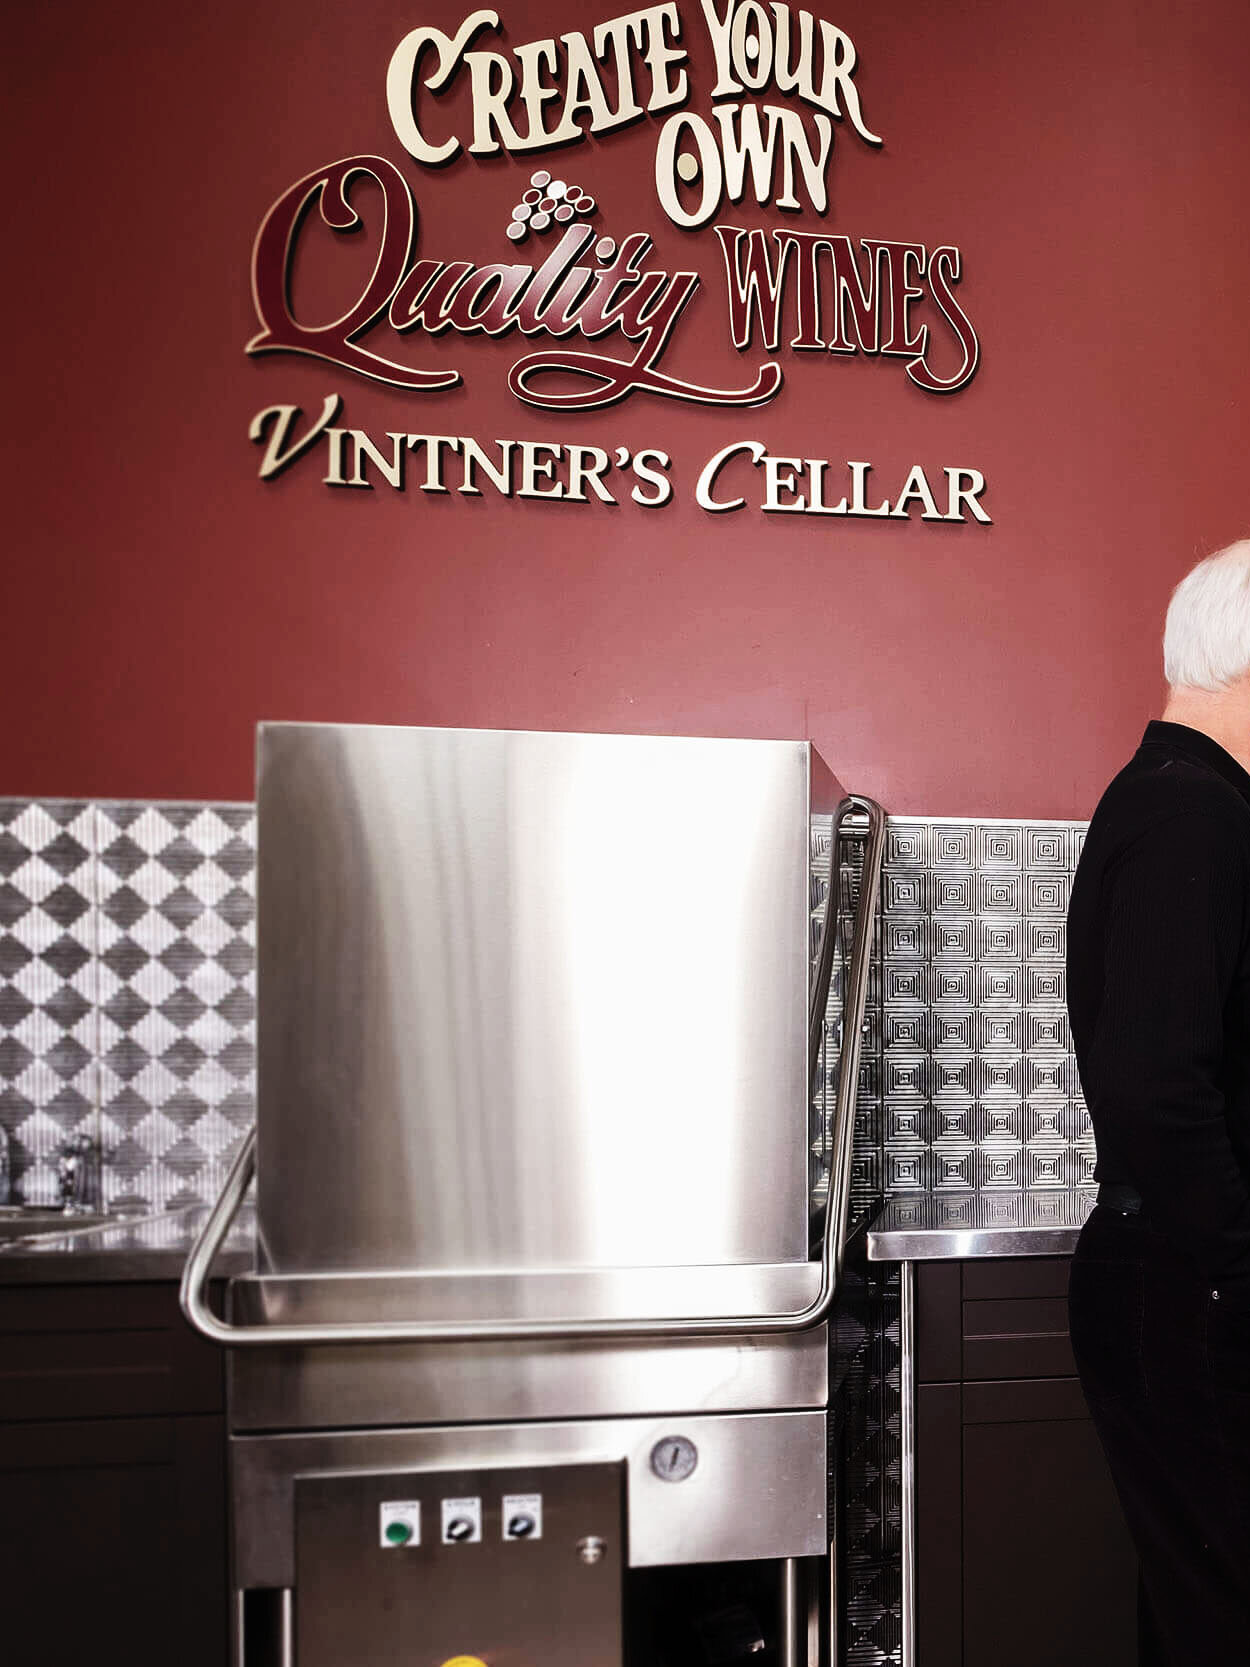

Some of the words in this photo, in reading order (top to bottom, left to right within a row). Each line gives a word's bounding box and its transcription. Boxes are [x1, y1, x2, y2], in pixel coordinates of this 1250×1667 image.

[386, 2, 689, 164] CREATE
[701, 0, 883, 143] YOUR
[655, 103, 832, 228] OWN
[244, 155, 785, 407] Quality
[715, 225, 979, 393] WINES
[248, 394, 672, 508] VINTNER'S
[695, 439, 993, 524] CELLAR
